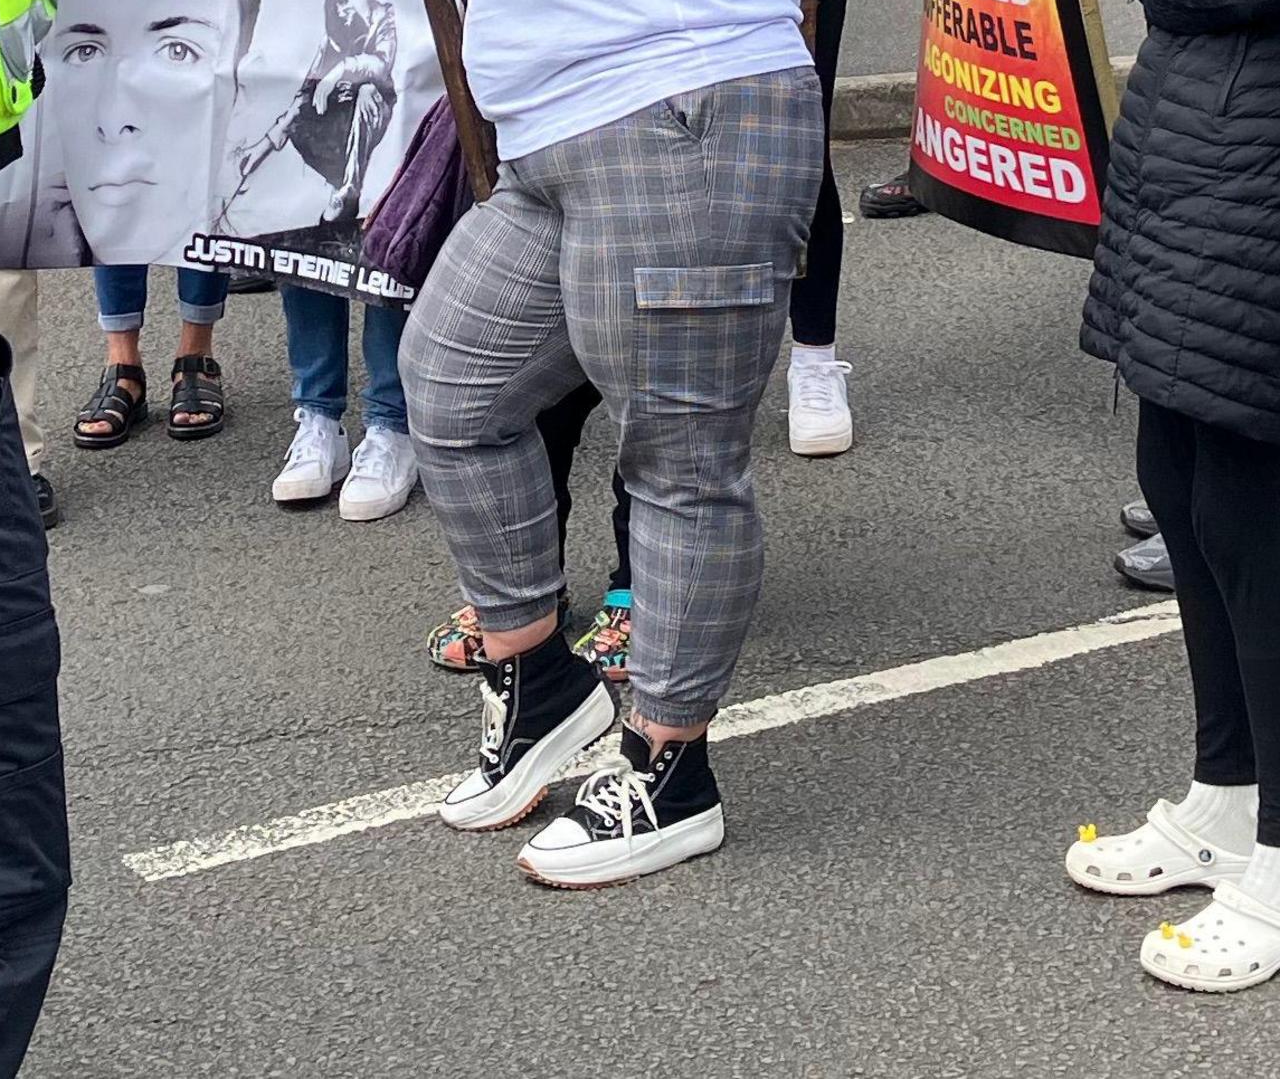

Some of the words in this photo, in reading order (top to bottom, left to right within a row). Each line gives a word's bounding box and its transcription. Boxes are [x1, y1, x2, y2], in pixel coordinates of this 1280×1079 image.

[924, 39, 1062, 114] AGONIZING
[914, 107, 1087, 204] ANGERED
[944, 95, 1081, 151] CONCERNED
[187, 237, 266, 269] JUSTIN
